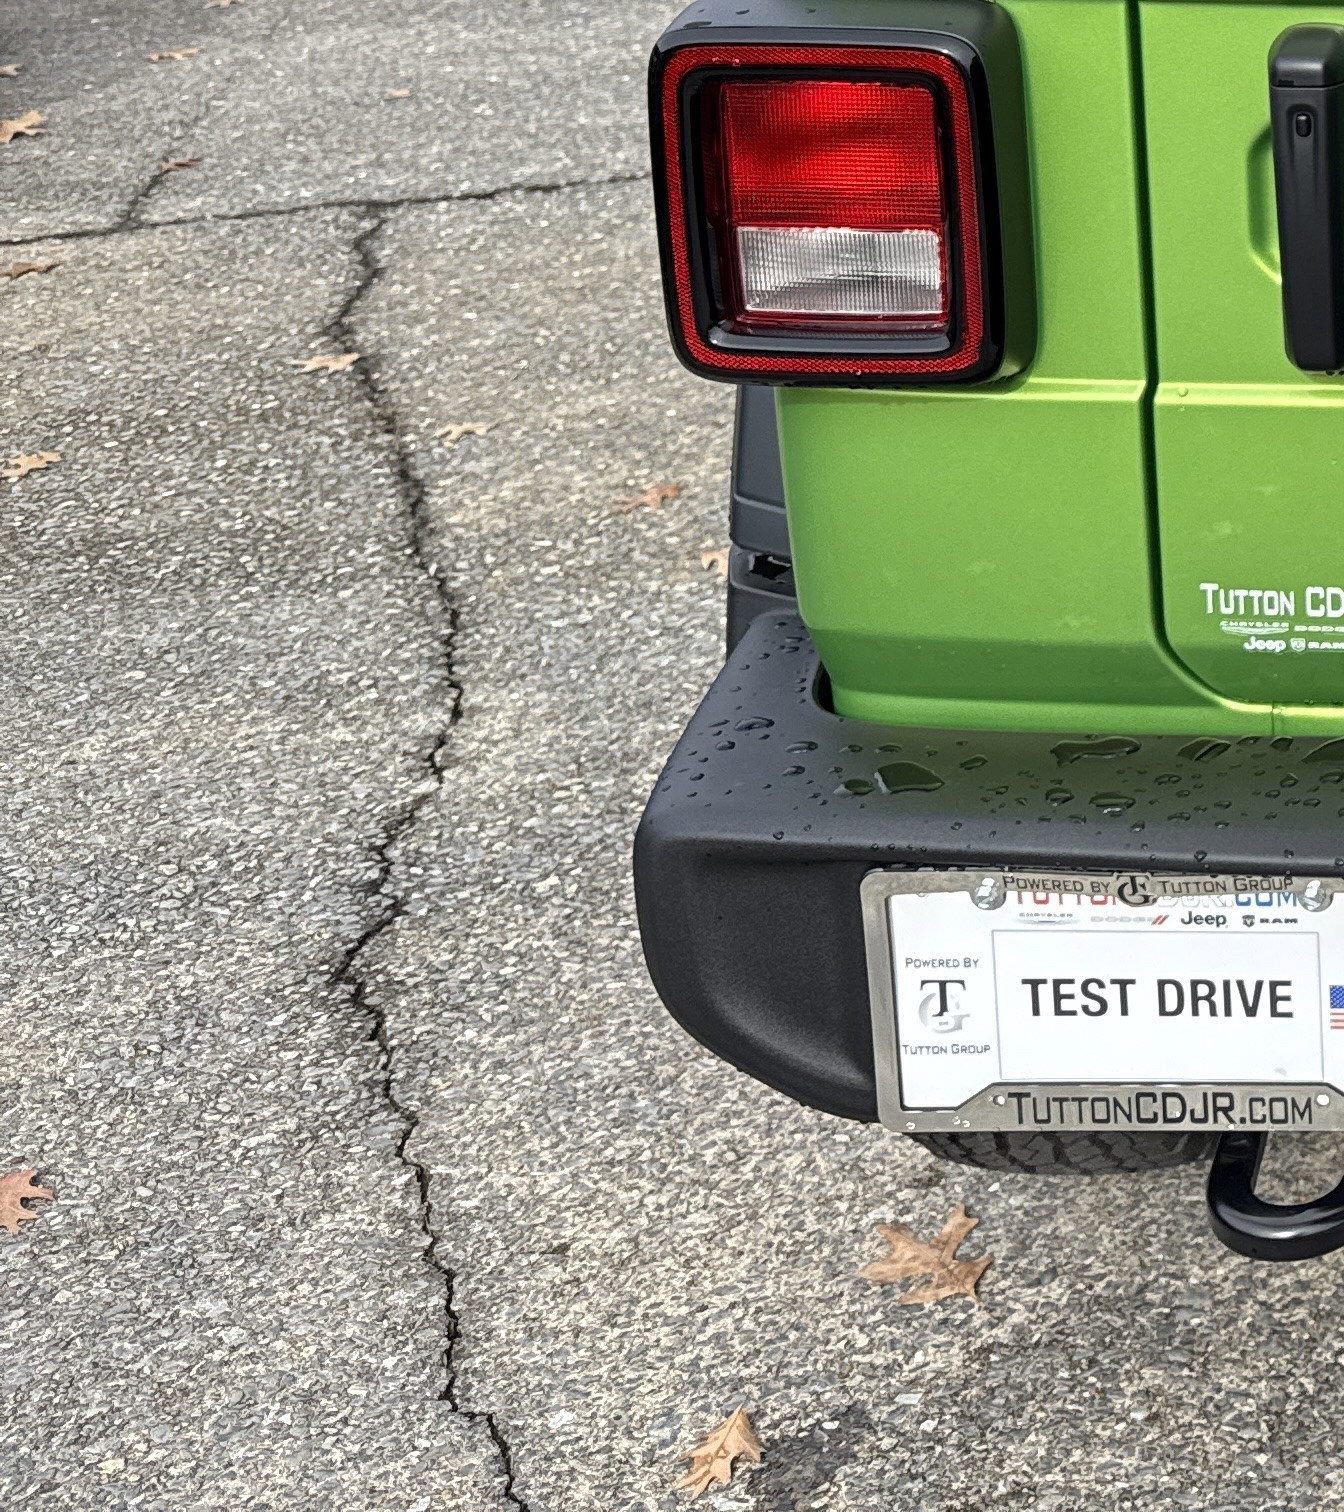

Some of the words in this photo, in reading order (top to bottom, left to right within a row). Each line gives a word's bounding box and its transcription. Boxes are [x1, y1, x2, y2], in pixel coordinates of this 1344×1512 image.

[1243, 637, 1286, 652] Jeep
[1181, 911, 1227, 928] Jeep
[1259, 917, 1298, 925] RAM
[1021, 978, 1137, 1017] TEST
[1157, 978, 1294, 1018] DRIVE
